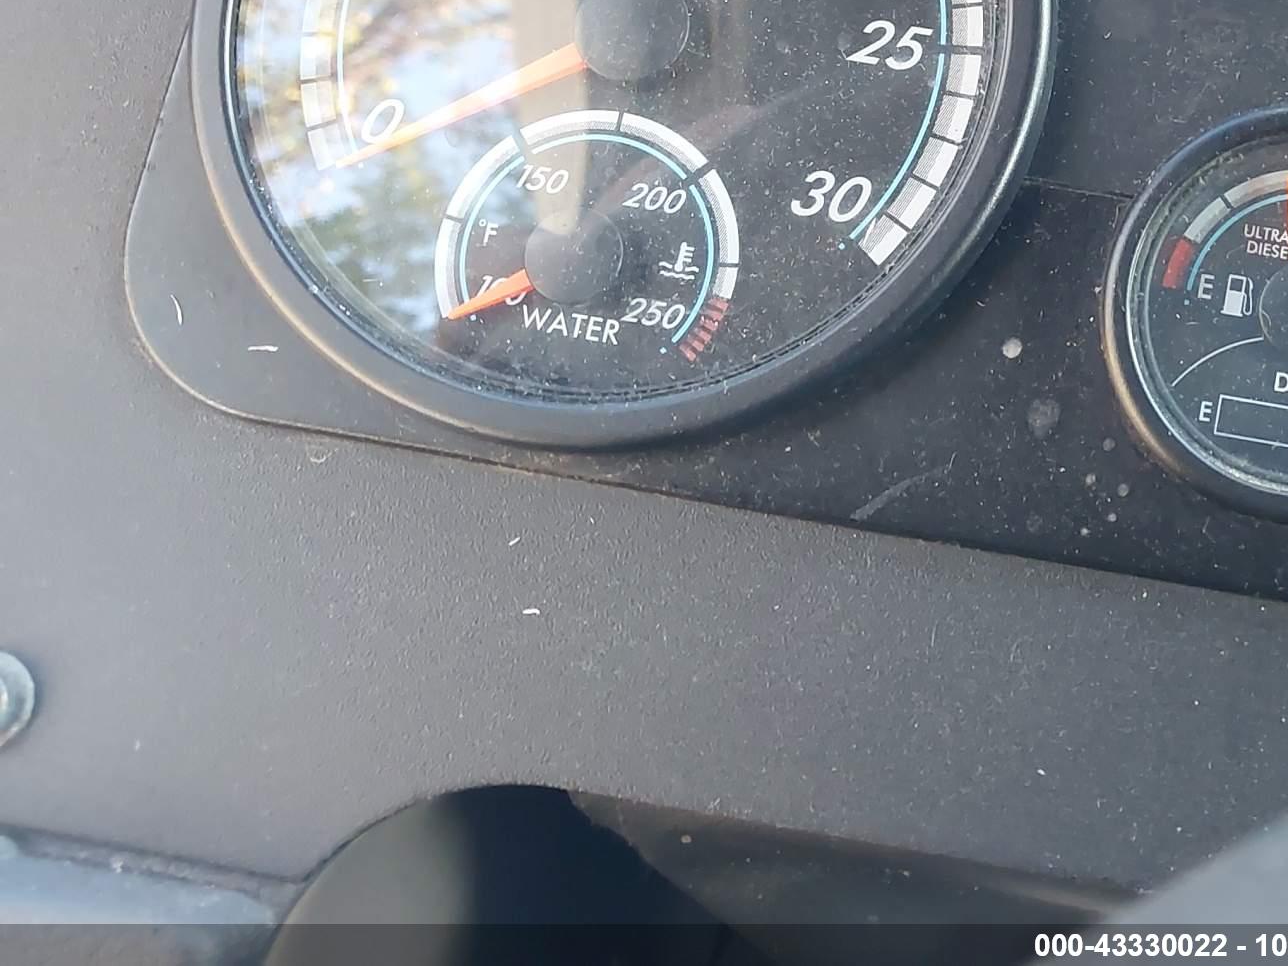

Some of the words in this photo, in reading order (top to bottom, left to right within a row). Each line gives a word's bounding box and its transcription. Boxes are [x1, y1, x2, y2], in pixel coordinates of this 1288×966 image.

[845, 19, 934, 70] 25
[361, 98, 405, 144] 0
[515, 164, 569, 195] 150
[622, 183, 687, 214] 200
[791, 170, 873, 223] 30
[1197, 273, 1215, 300] E
[522, 304, 621, 346] WATER
[621, 297, 686, 330] 250
[1198, 401, 1213, 422] E
